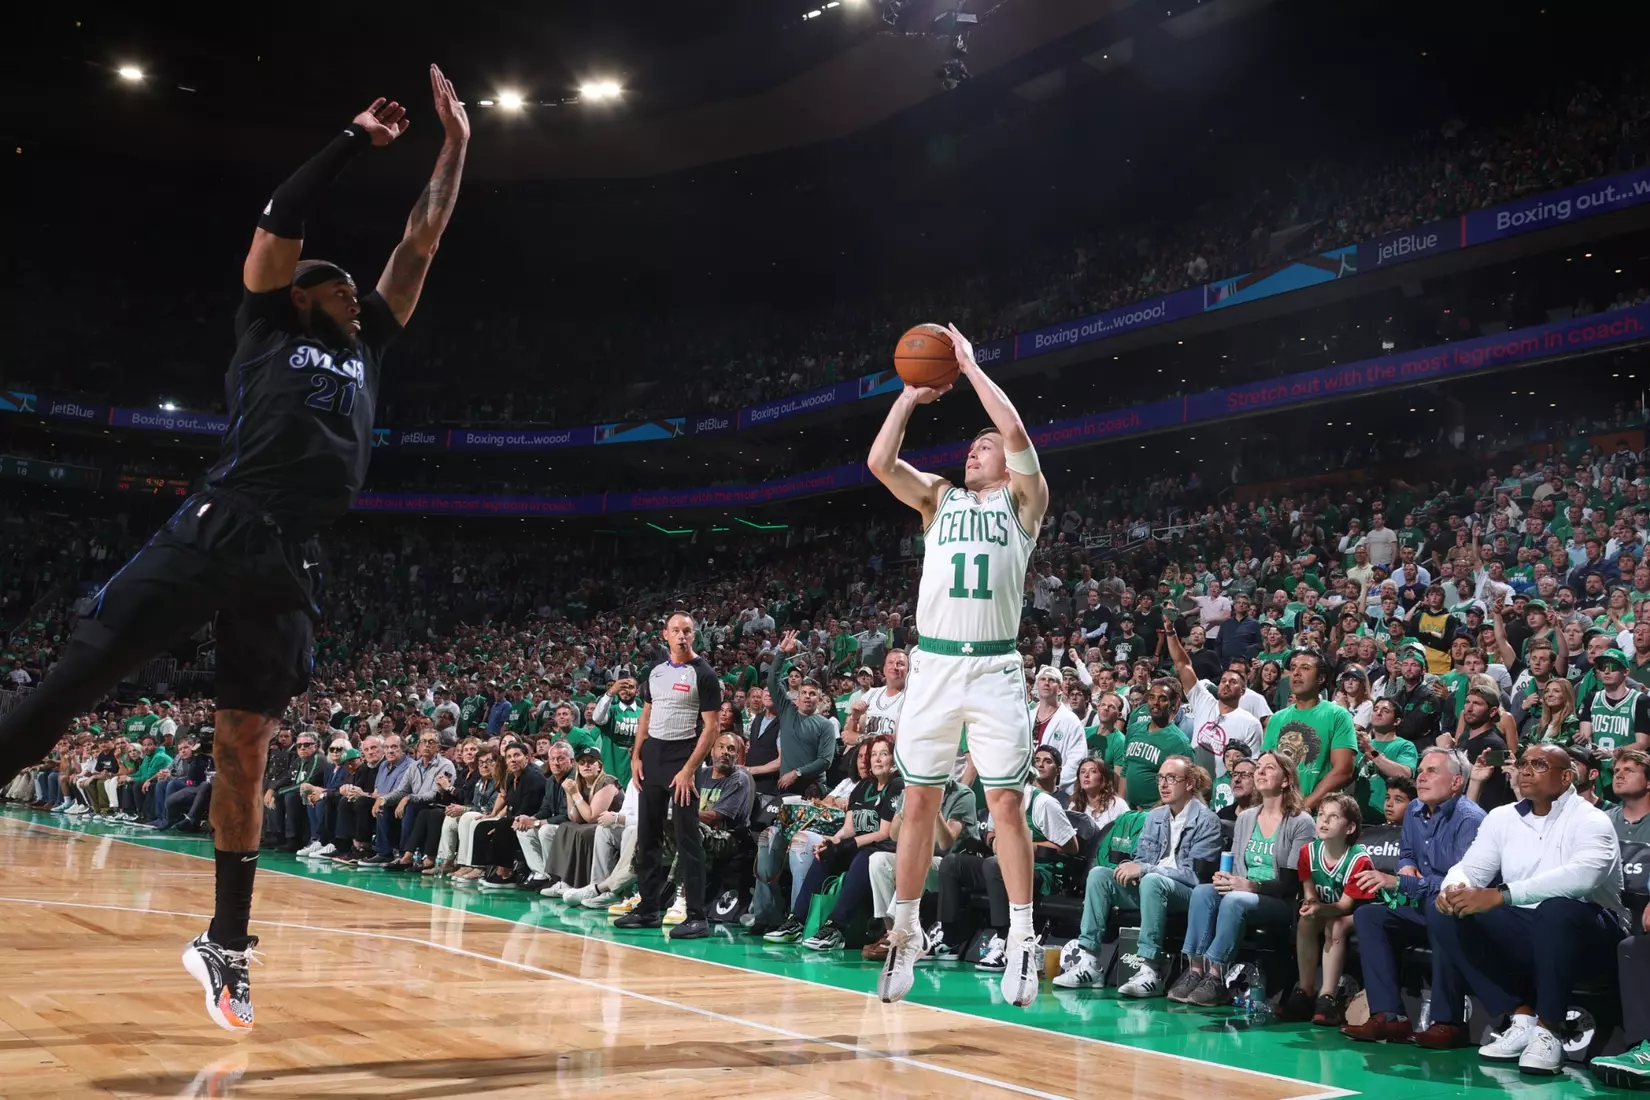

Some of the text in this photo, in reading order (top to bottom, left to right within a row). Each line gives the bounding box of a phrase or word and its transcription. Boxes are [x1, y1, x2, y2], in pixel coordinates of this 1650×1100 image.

[1497, 199, 1571, 230] Boxing
[1377, 234, 1437, 265] jetBlue
[1035, 301, 1166, 348] Boxing out...woooo!
[1227, 313, 1645, 408] Stretch out with the most legroom in coach.
[50, 400, 94, 419] jetBlue
[304, 373, 356, 416] 21
[132, 412, 172, 429] Boxing
[695, 417, 729, 434] jetBlue
[751, 403, 780, 421] Boxing
[400, 432, 436, 446] jetBlue
[466, 432, 504, 447] Boxing
[938, 509, 1008, 547] CELTICS
[949, 552, 992, 600] 11
